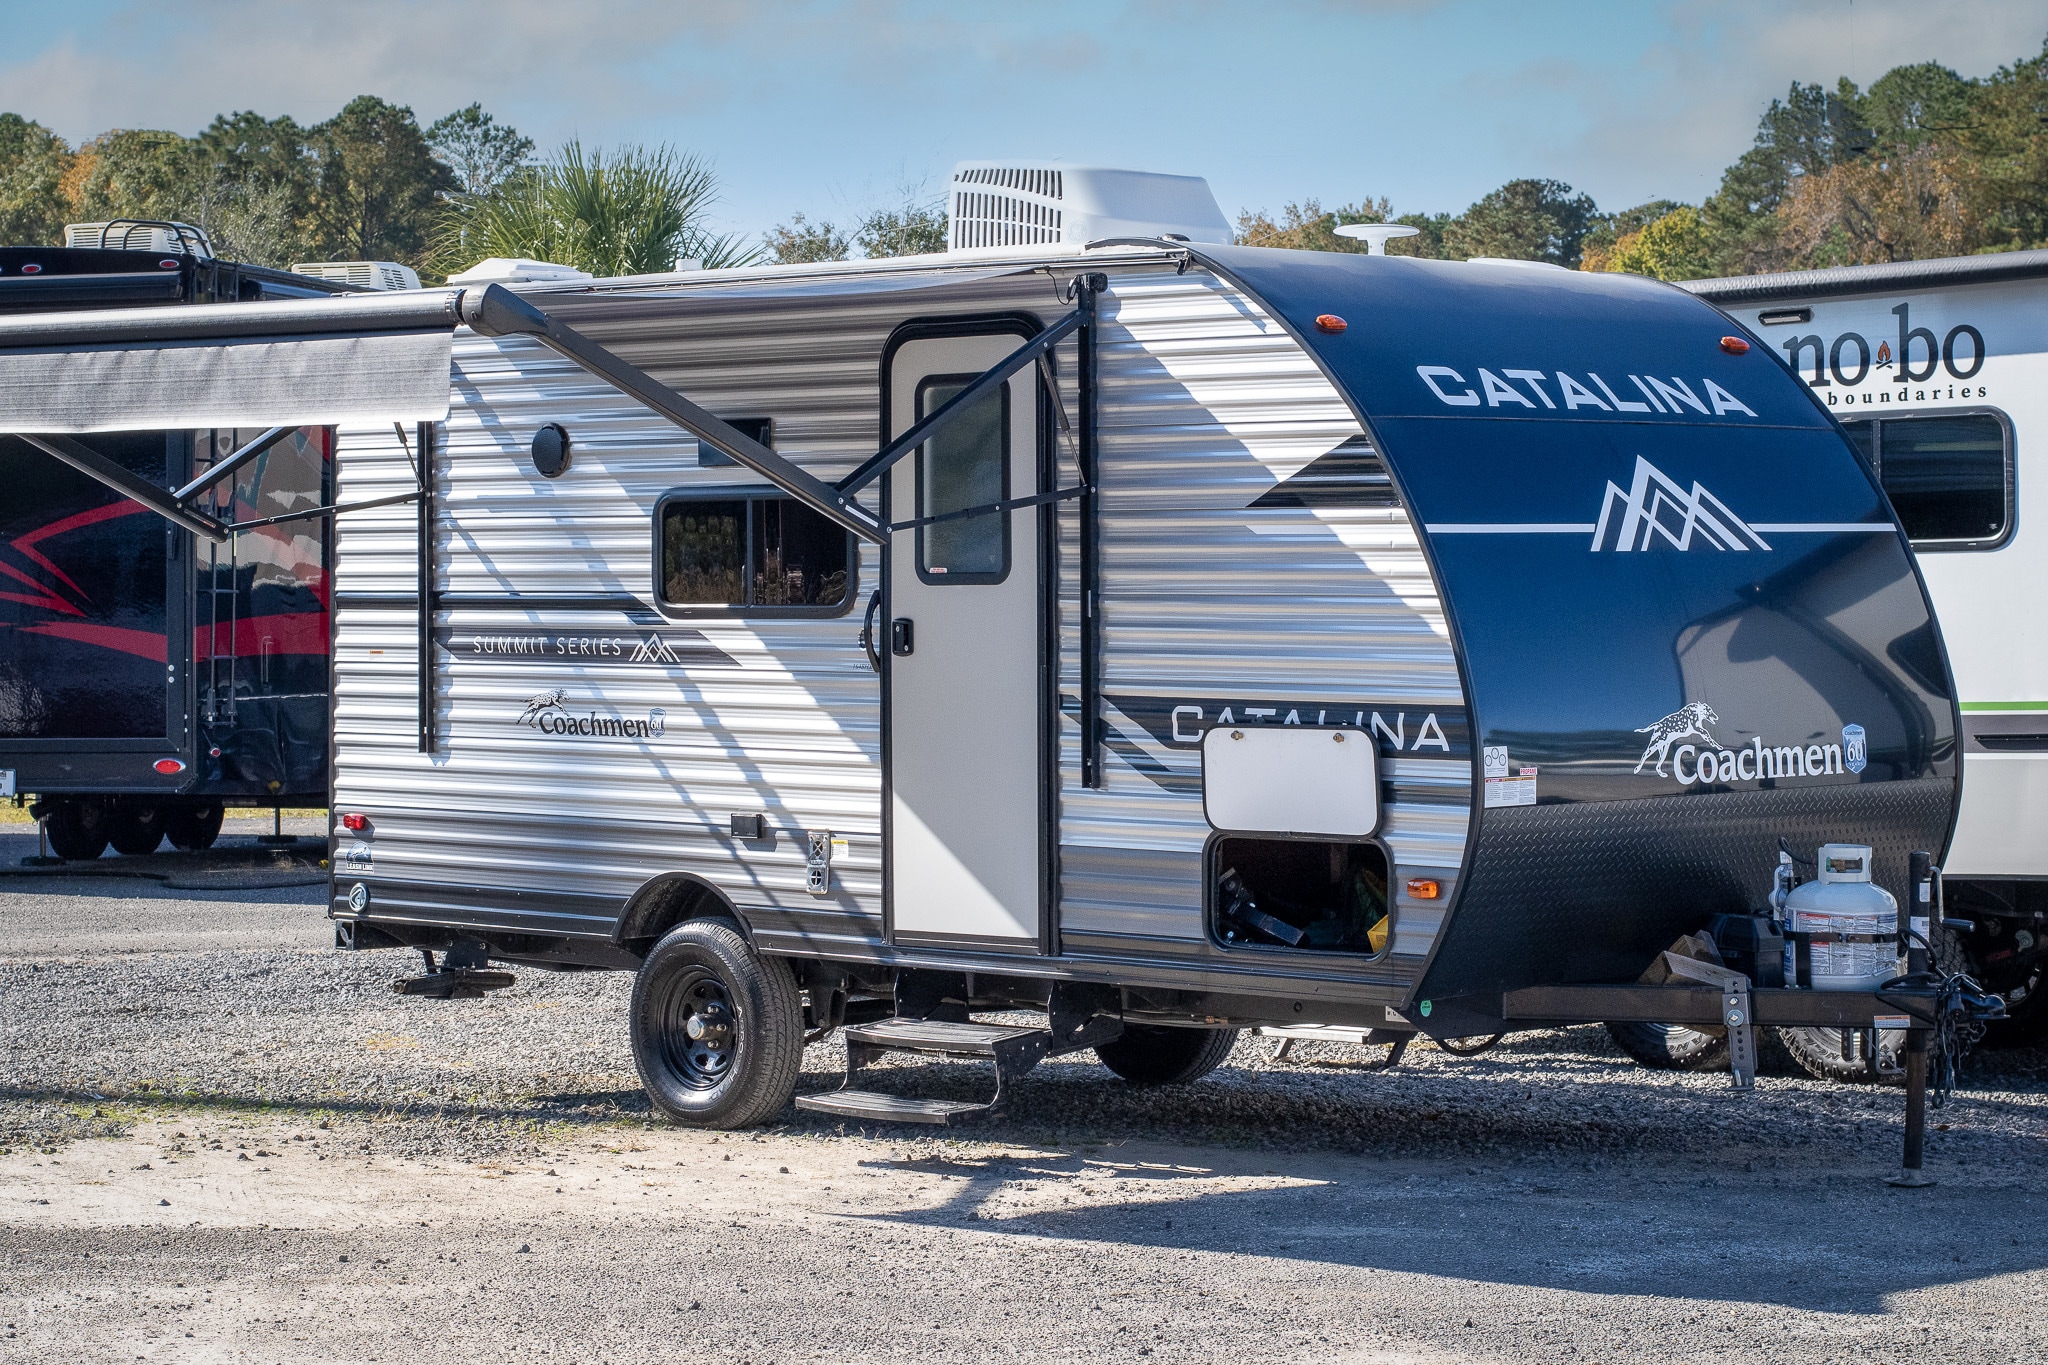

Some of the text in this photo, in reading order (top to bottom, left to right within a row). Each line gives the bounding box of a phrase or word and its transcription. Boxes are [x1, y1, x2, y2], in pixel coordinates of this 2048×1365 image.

[1416, 365, 1758, 417] CATALINA
[1827, 384, 1987, 405] boundaries
[473, 636, 622, 656] SUMMIT SERIES
[538, 711, 650, 738] Coachmen
[1673, 736, 1845, 785] Coachmen
[1847, 740, 1864, 762] 60
